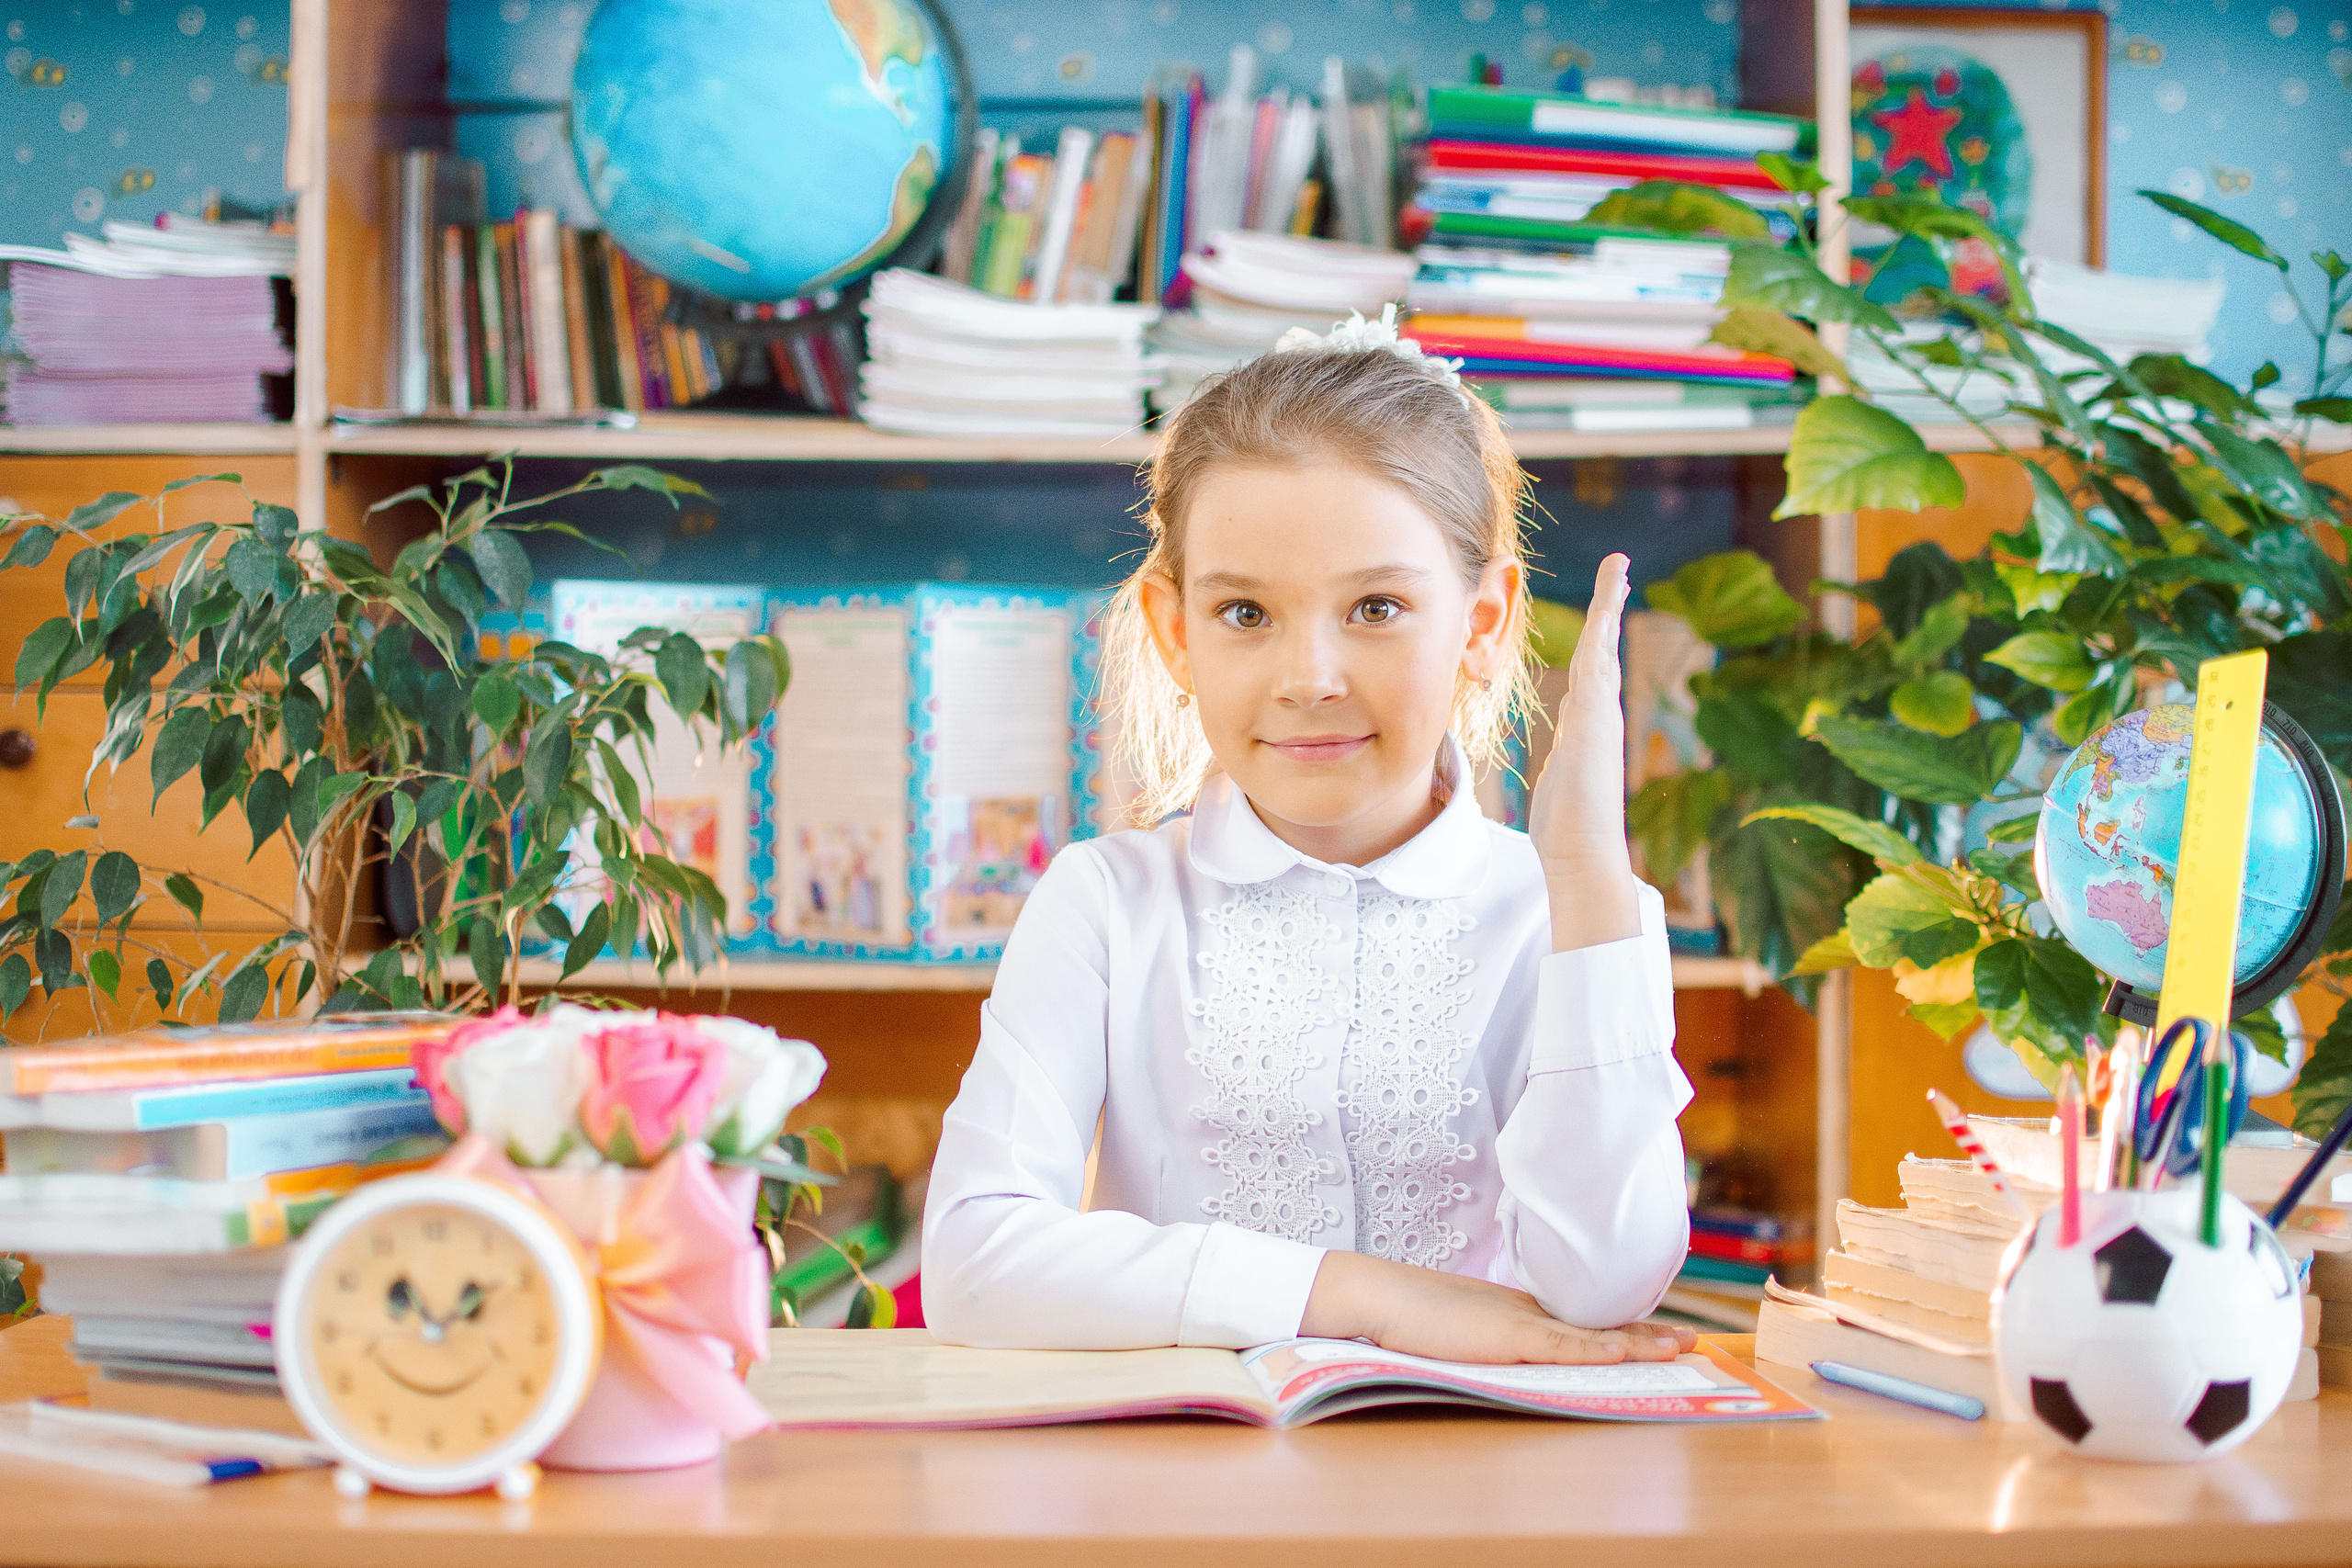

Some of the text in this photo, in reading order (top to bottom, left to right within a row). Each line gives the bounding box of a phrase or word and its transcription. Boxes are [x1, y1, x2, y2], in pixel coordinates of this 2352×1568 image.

[2210, 671, 2220, 683] 30
[2207, 694, 2217, 708] 29
[2204, 718, 2214, 732] 28
[2201, 742, 2211, 756] 27
[2199, 764, 2209, 779] 26
[2196, 789, 2206, 803] 25
[2190, 837, 2200, 852] 23
